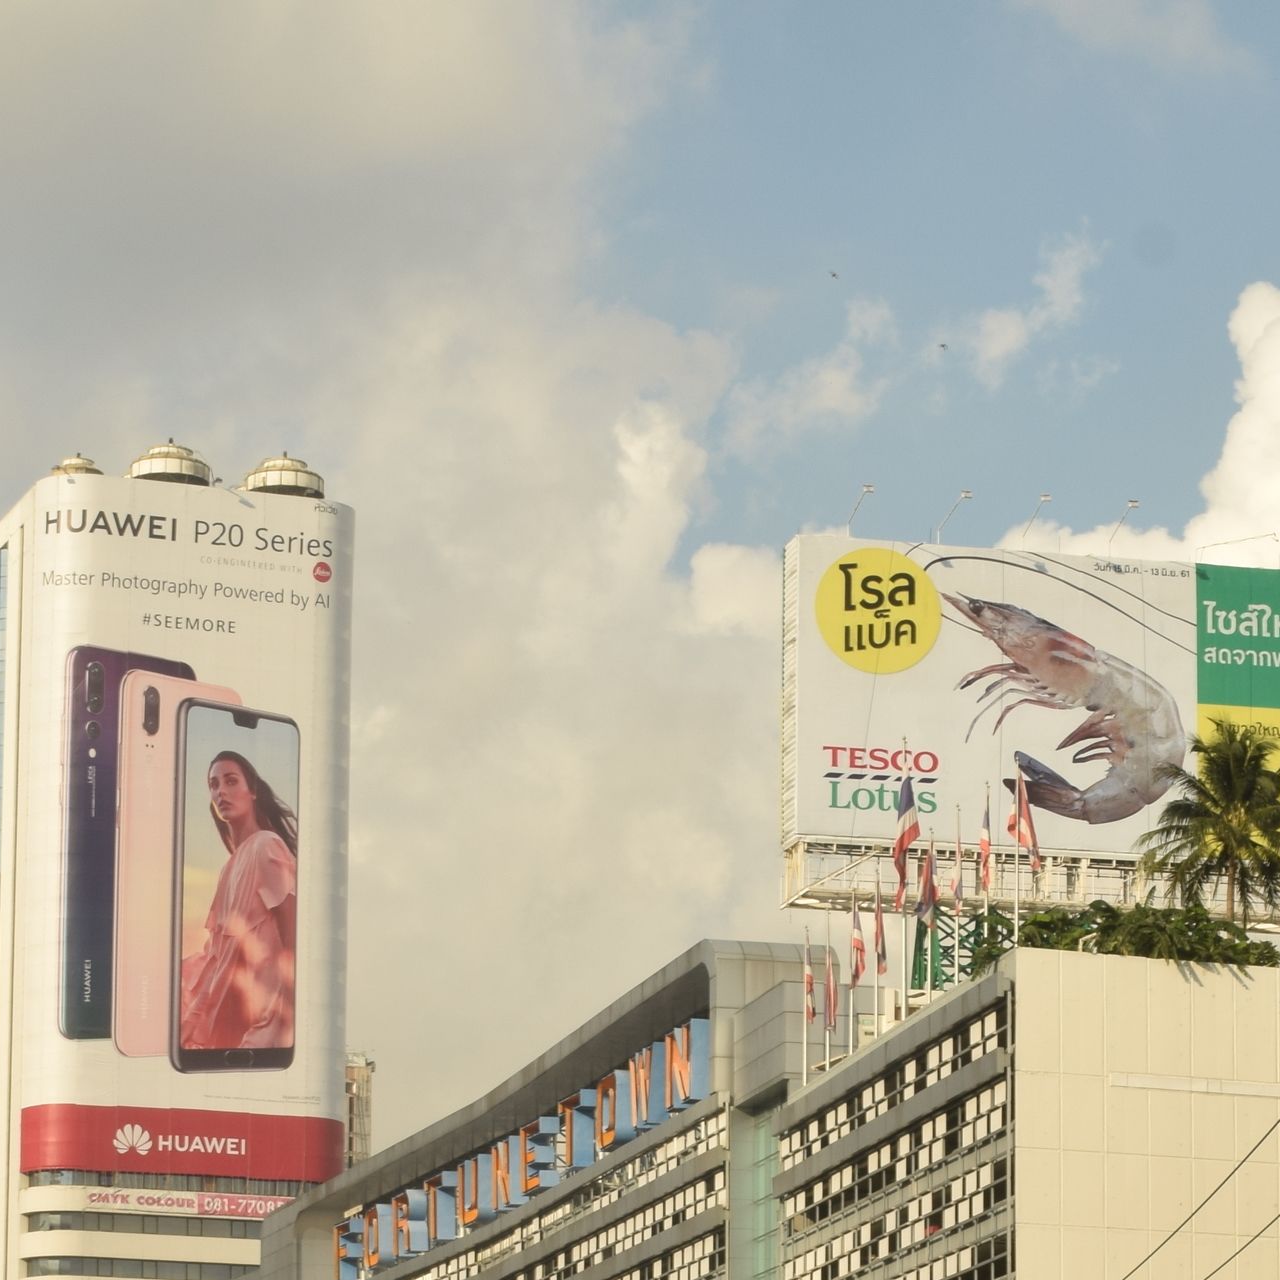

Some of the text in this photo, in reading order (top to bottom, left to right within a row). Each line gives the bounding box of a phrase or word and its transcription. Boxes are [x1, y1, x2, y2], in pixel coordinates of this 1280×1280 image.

[45, 508, 333, 558] HUAWEI P20 Series
[280, 563, 303, 575] WITH
[1151, 568, 1159, 576] 13
[42, 570, 331, 611] Master Photography Powered by AI
[839, 562, 916, 612] โรล
[143, 613, 237, 634] #SEEMORE
[843, 609, 917, 653] แบ็ค
[823, 745, 939, 773] TESCO
[558, 1018, 711, 1168] TOWN
[158, 1134, 246, 1156] HUAWEI
[88, 1190, 129, 1205] CMYK
[137, 1195, 195, 1209] COLOUR
